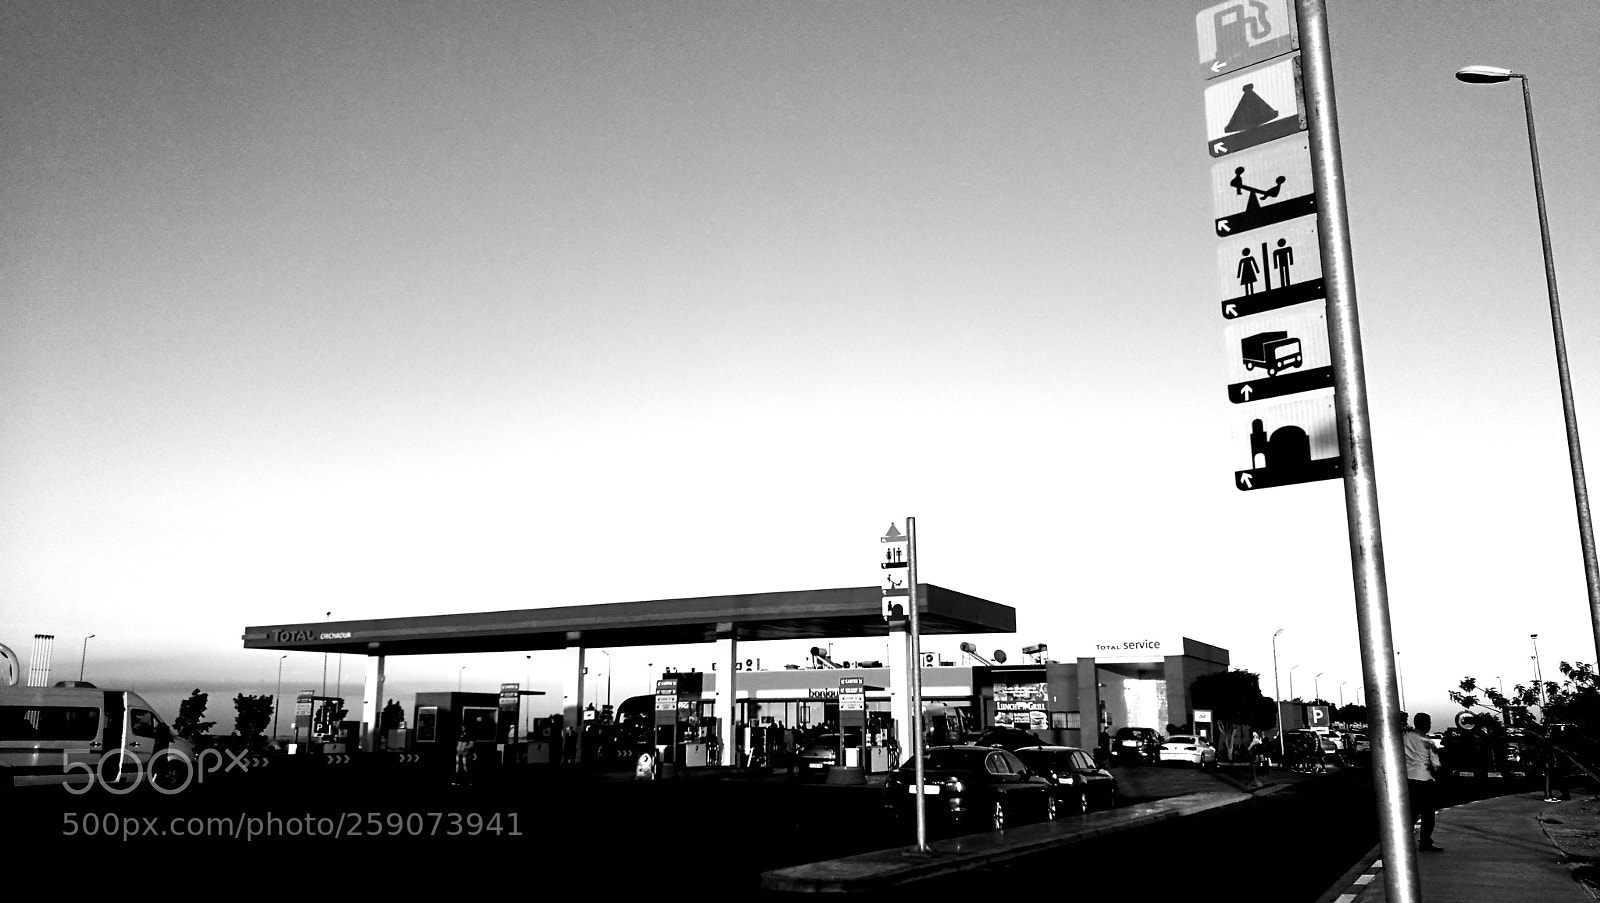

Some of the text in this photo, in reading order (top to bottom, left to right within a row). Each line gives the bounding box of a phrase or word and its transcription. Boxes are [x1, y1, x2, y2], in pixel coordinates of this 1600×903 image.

[272, 629, 316, 642] TOTAL
[1123, 639, 1160, 649] service
[809, 688, 839, 699] bonjou
[1312, 707, 1324, 724] P
